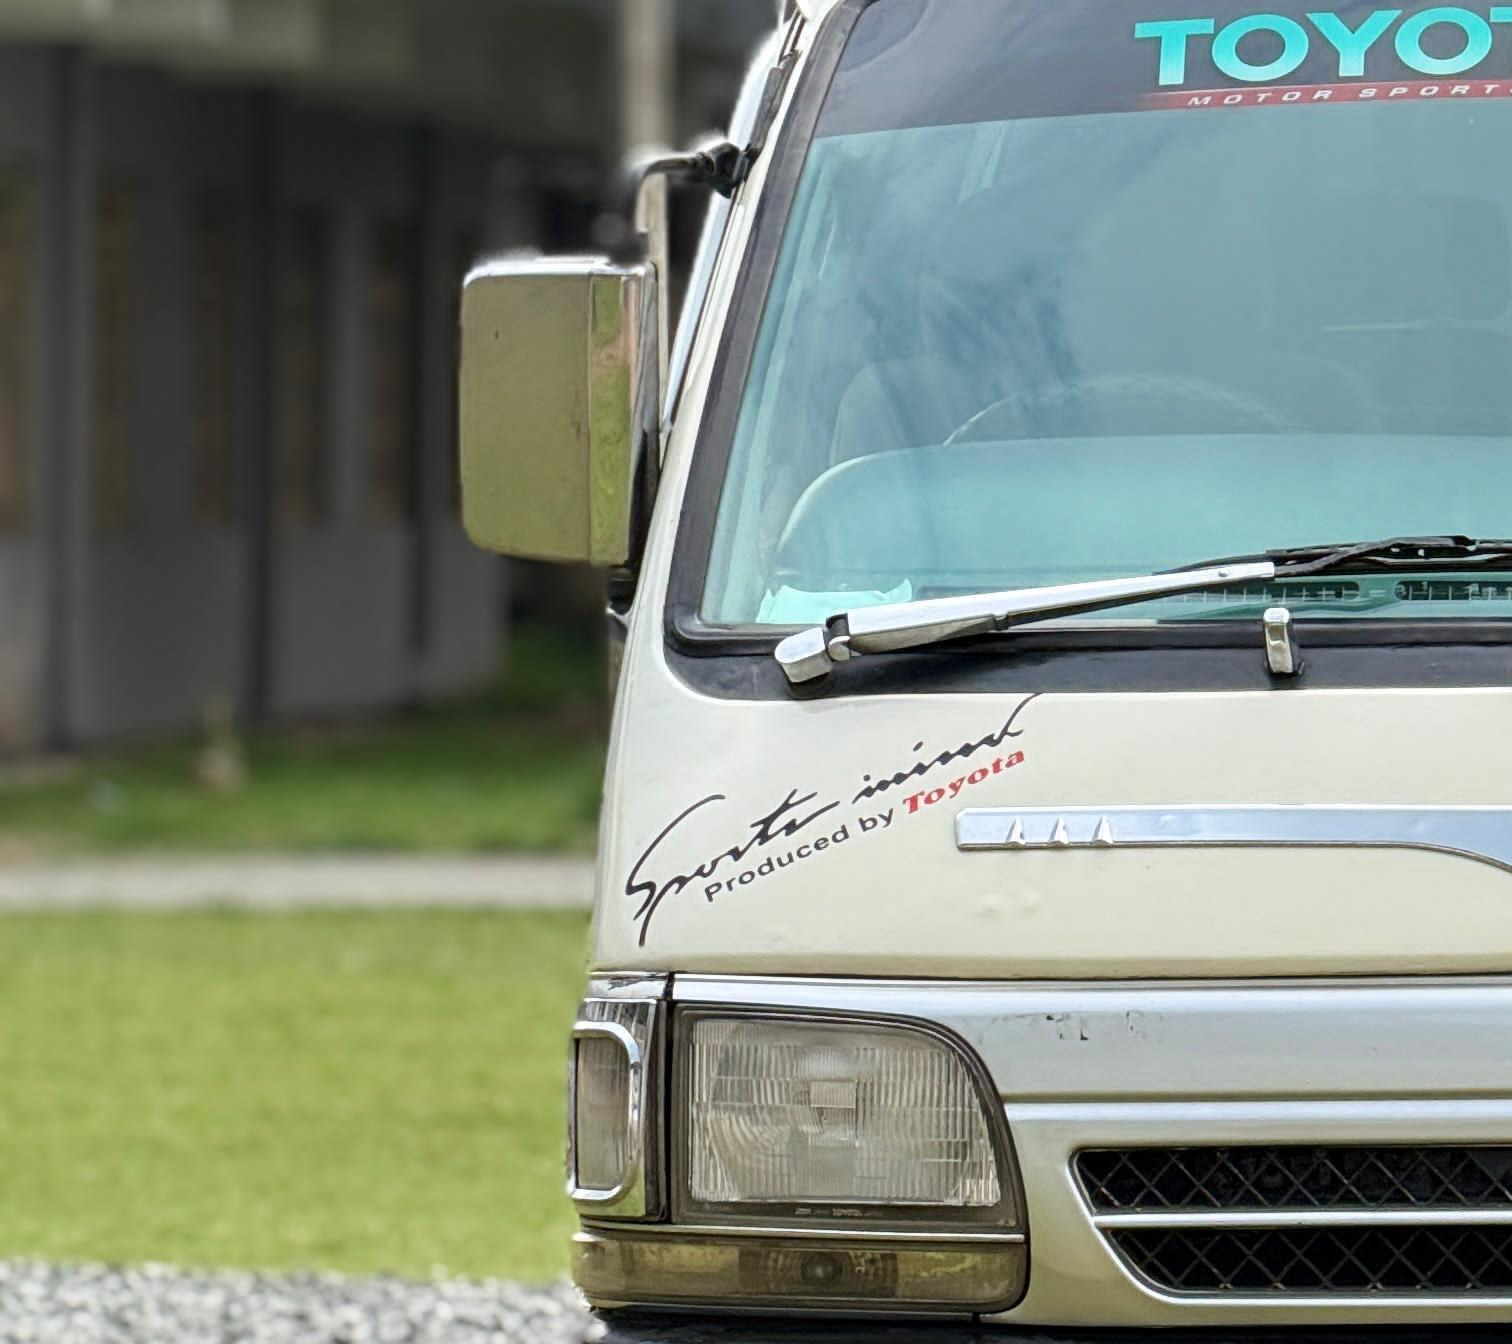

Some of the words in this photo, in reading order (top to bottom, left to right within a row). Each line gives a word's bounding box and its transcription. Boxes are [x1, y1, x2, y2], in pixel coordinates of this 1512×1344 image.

[1188, 88, 1333, 106] MOTOR
[705, 824, 849, 903] Produced
[858, 808, 894, 833] by
[903, 748, 1025, 814] Toyota
